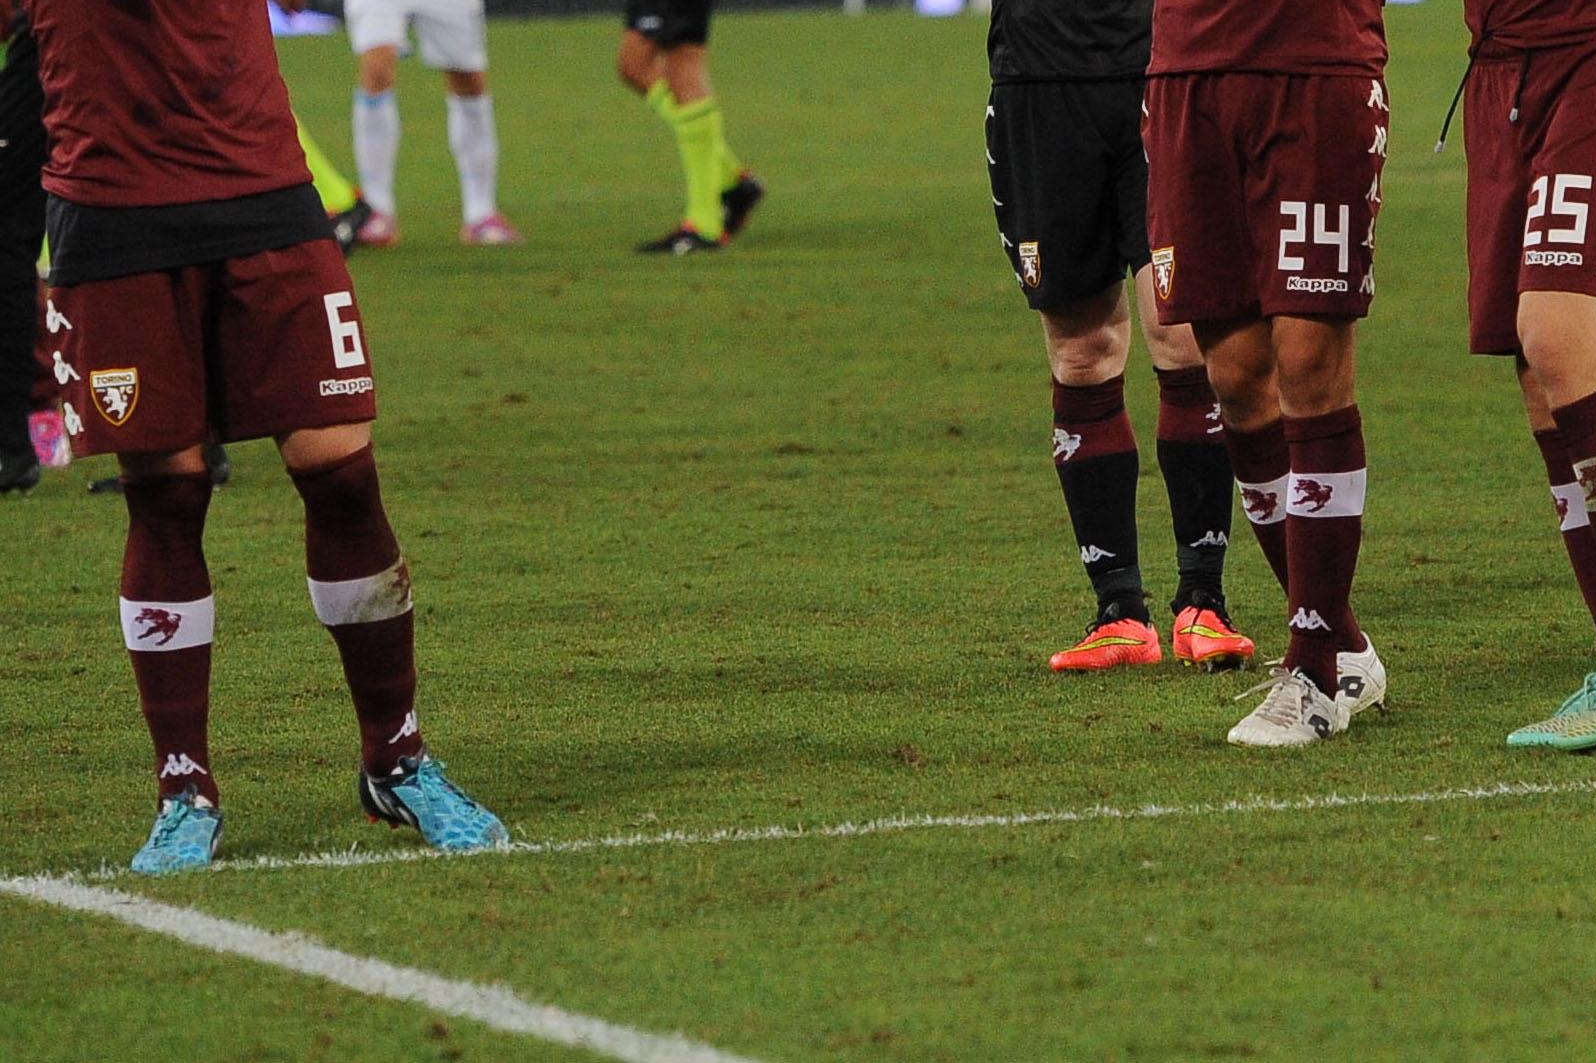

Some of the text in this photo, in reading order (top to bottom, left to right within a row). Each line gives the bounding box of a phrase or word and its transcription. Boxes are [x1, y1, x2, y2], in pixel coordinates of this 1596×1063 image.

[1277, 200, 1349, 273] 24
[1523, 173, 1593, 248] 25
[1287, 276, 1348, 292] Kappa
[1525, 250, 1583, 266] Kappa
[323, 291, 366, 369] 6
